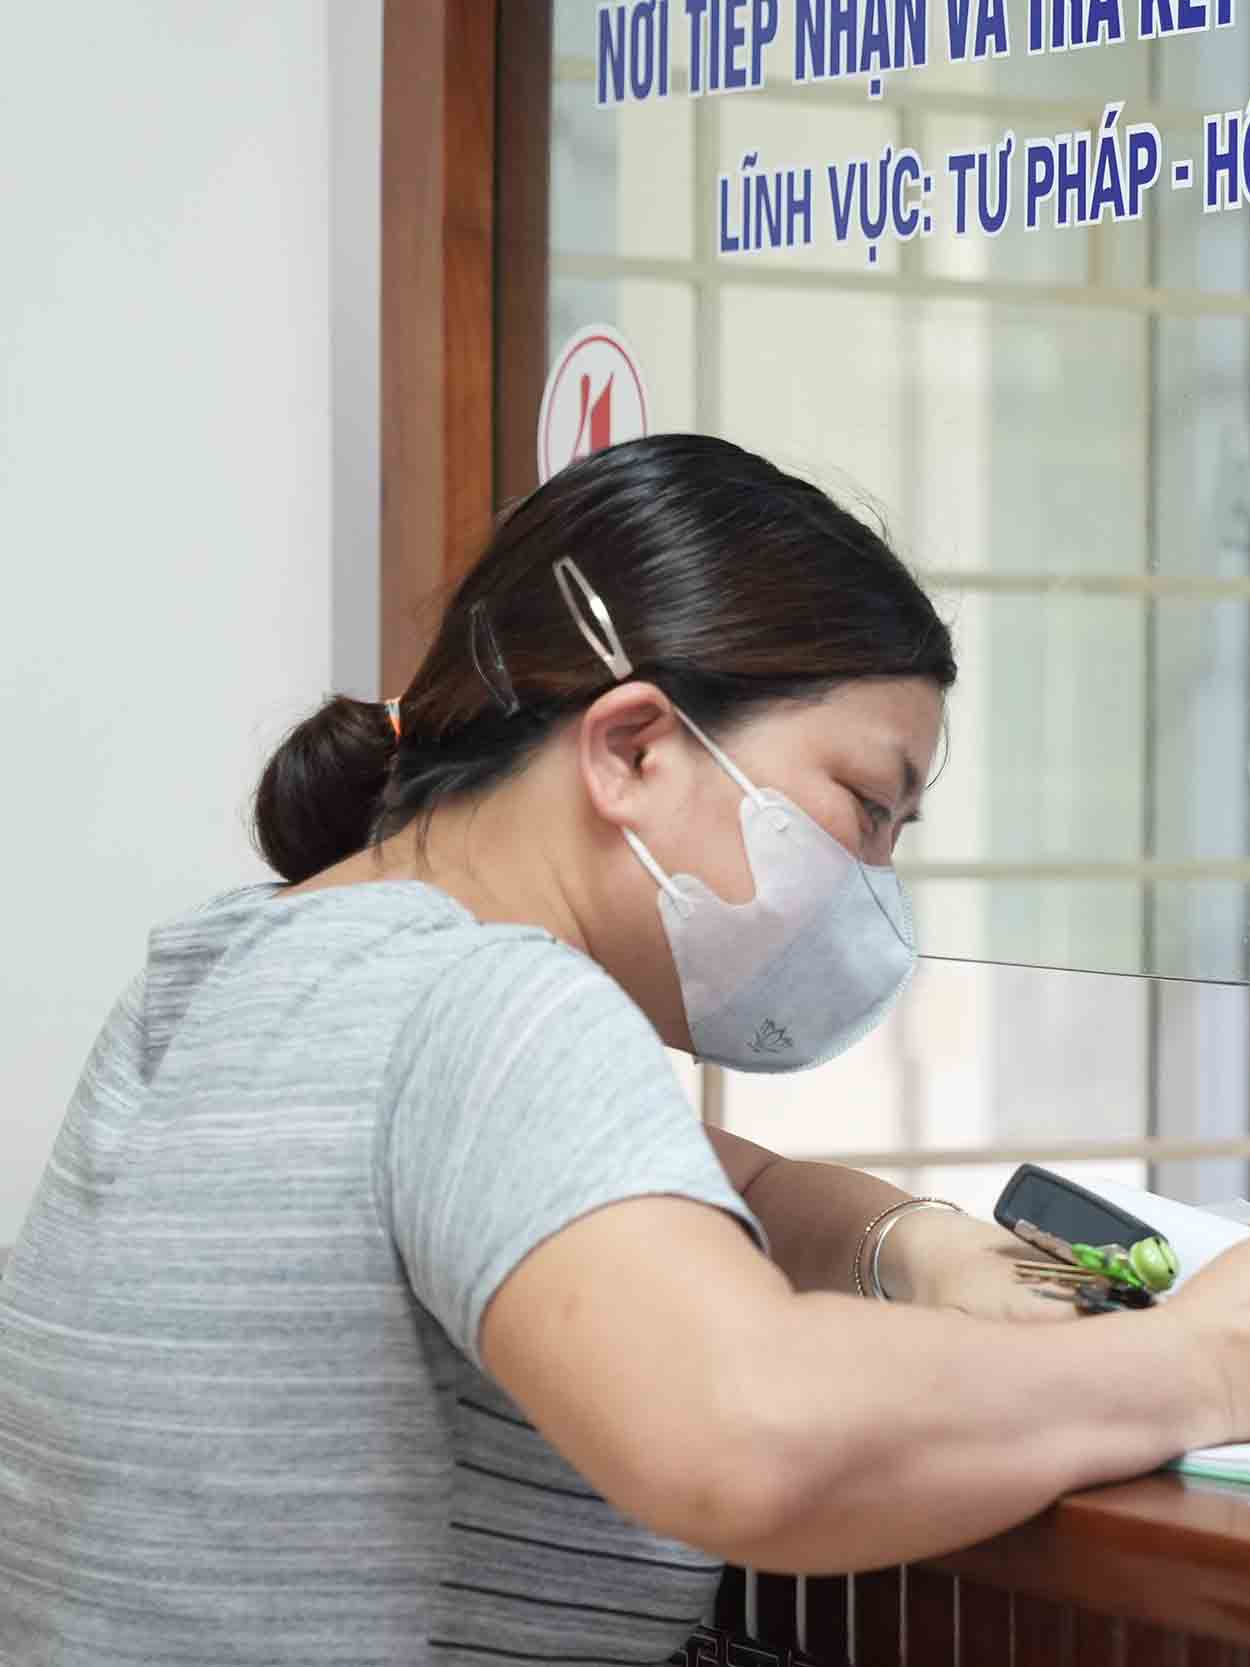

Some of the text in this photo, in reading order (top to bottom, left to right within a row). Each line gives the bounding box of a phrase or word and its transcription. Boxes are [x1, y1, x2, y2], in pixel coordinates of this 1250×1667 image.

[720, 151, 812, 253] LĨNH
[827, 147, 932, 263] VỰC:
[948, 137, 1013, 234] TƯ
[1026, 109, 1158, 228] PHÁP
